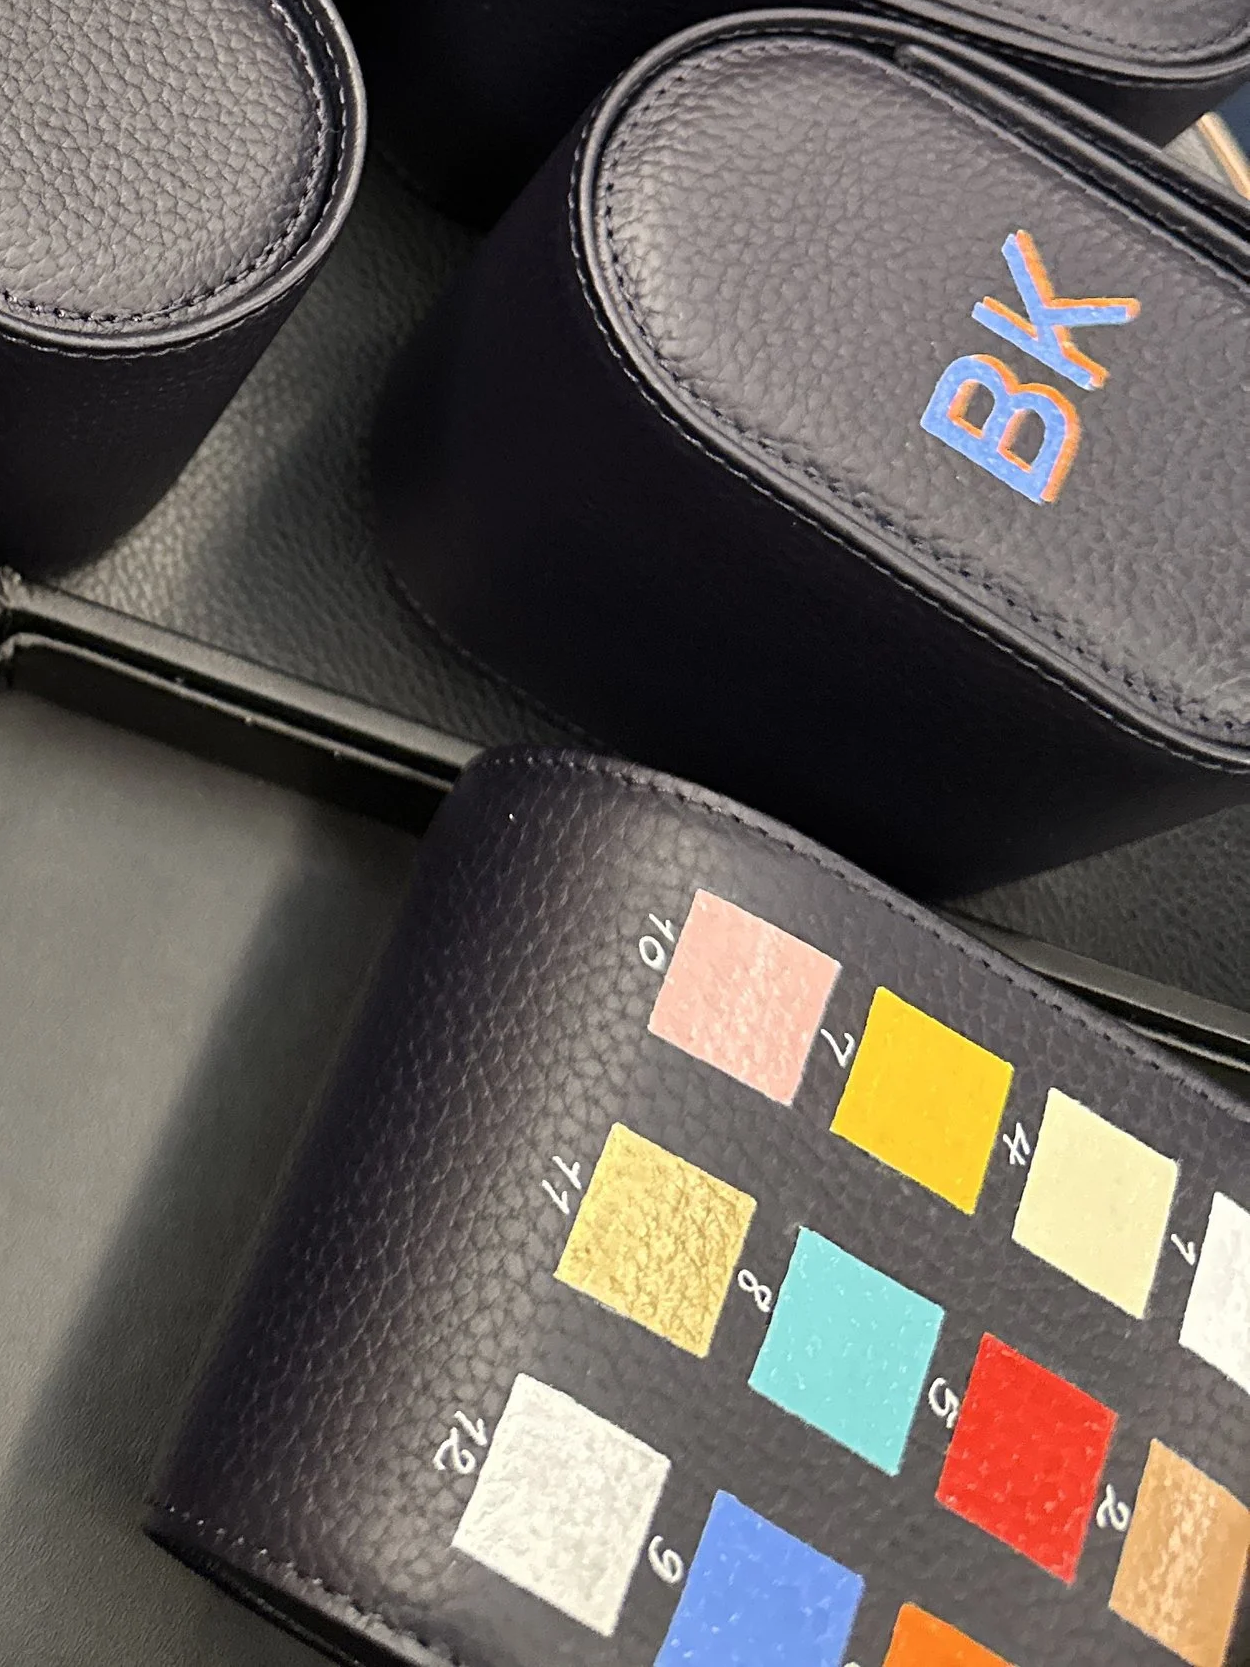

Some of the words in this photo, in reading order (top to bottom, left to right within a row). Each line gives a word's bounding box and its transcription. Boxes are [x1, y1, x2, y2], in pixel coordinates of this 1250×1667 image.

[918, 228, 1140, 504] BK
[637, 913, 676, 972] 10
[819, 1028, 855, 1067] 7
[1003, 1122, 1031, 1166] 4
[541, 1155, 583, 1214] 11
[1170, 1233, 1198, 1265] 1
[737, 1268, 773, 1314] 8
[928, 1377, 960, 1429] 5
[433, 1410, 488, 1476] 12
[1095, 1484, 1130, 1531] 2
[647, 1535, 685, 1586] 9
